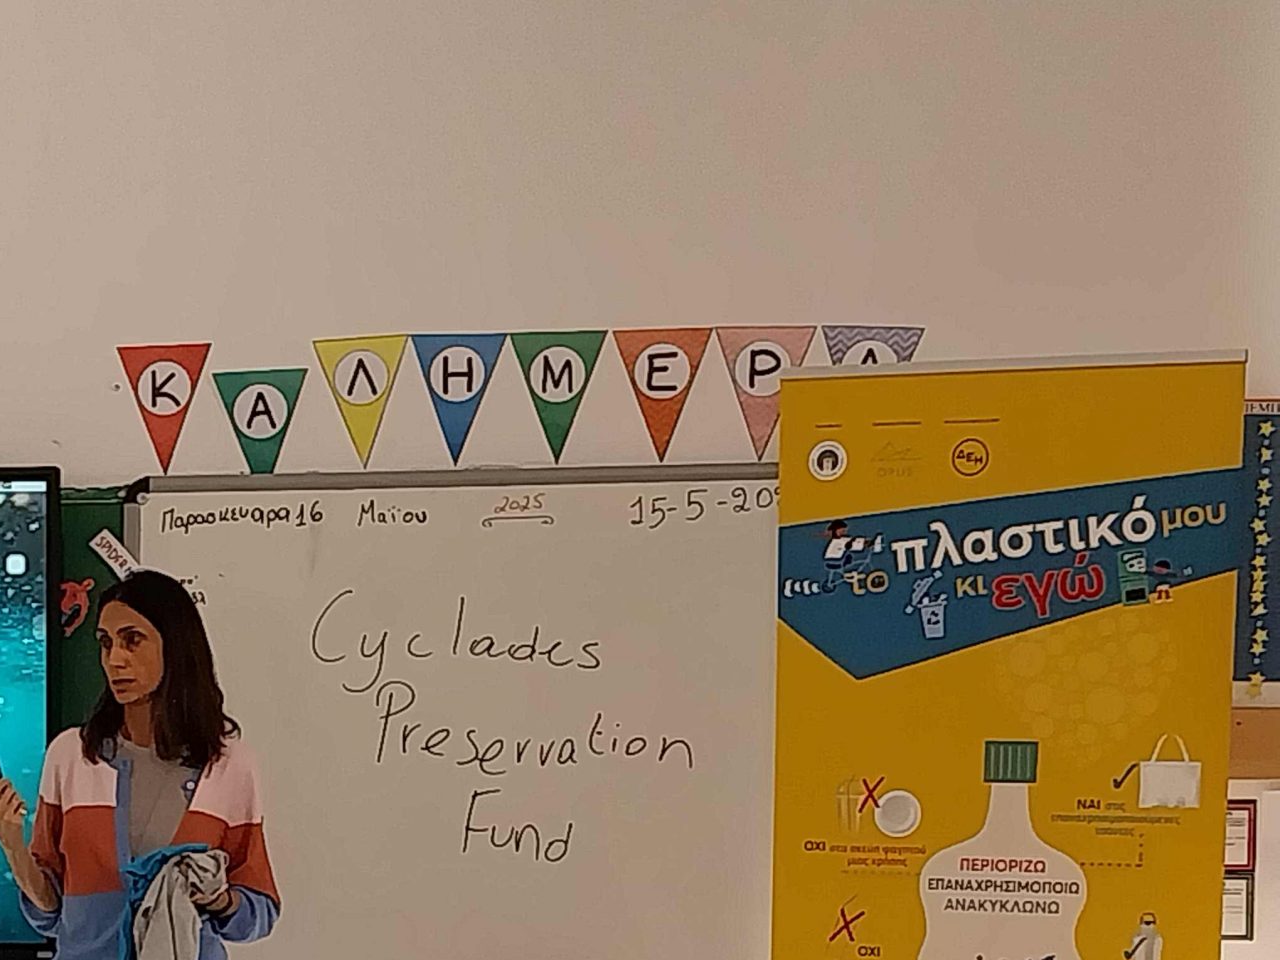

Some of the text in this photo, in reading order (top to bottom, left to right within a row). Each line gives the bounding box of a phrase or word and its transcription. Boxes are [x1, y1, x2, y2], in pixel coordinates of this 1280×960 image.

[955, 449, 983, 465] ΔΕΗ
[296, 500, 323, 527] 16
[493, 493, 546, 514] 2025
[847, 495, 1227, 596] το πλαστικό μου
[955, 551, 1106, 618] κι εγώ
[312, 589, 601, 694] Cyclades
[376, 681, 693, 775] Preservation
[1077, 799, 1101, 810] ΝΑΙ
[462, 789, 574, 863] Fund
[804, 840, 826, 851] ΟΧΙ
[959, 857, 1046, 873] ΠΕΡΙΟΡΙΖΩ
[928, 878, 1080, 894] ΕΠΑΝΑΧΡΗΣΙΜΟΠΟΙΩ
[944, 898, 1060, 914] ΑΝΑΚΥΚΛΩΝΩ
[857, 945, 881, 957] ΟΧΙ
